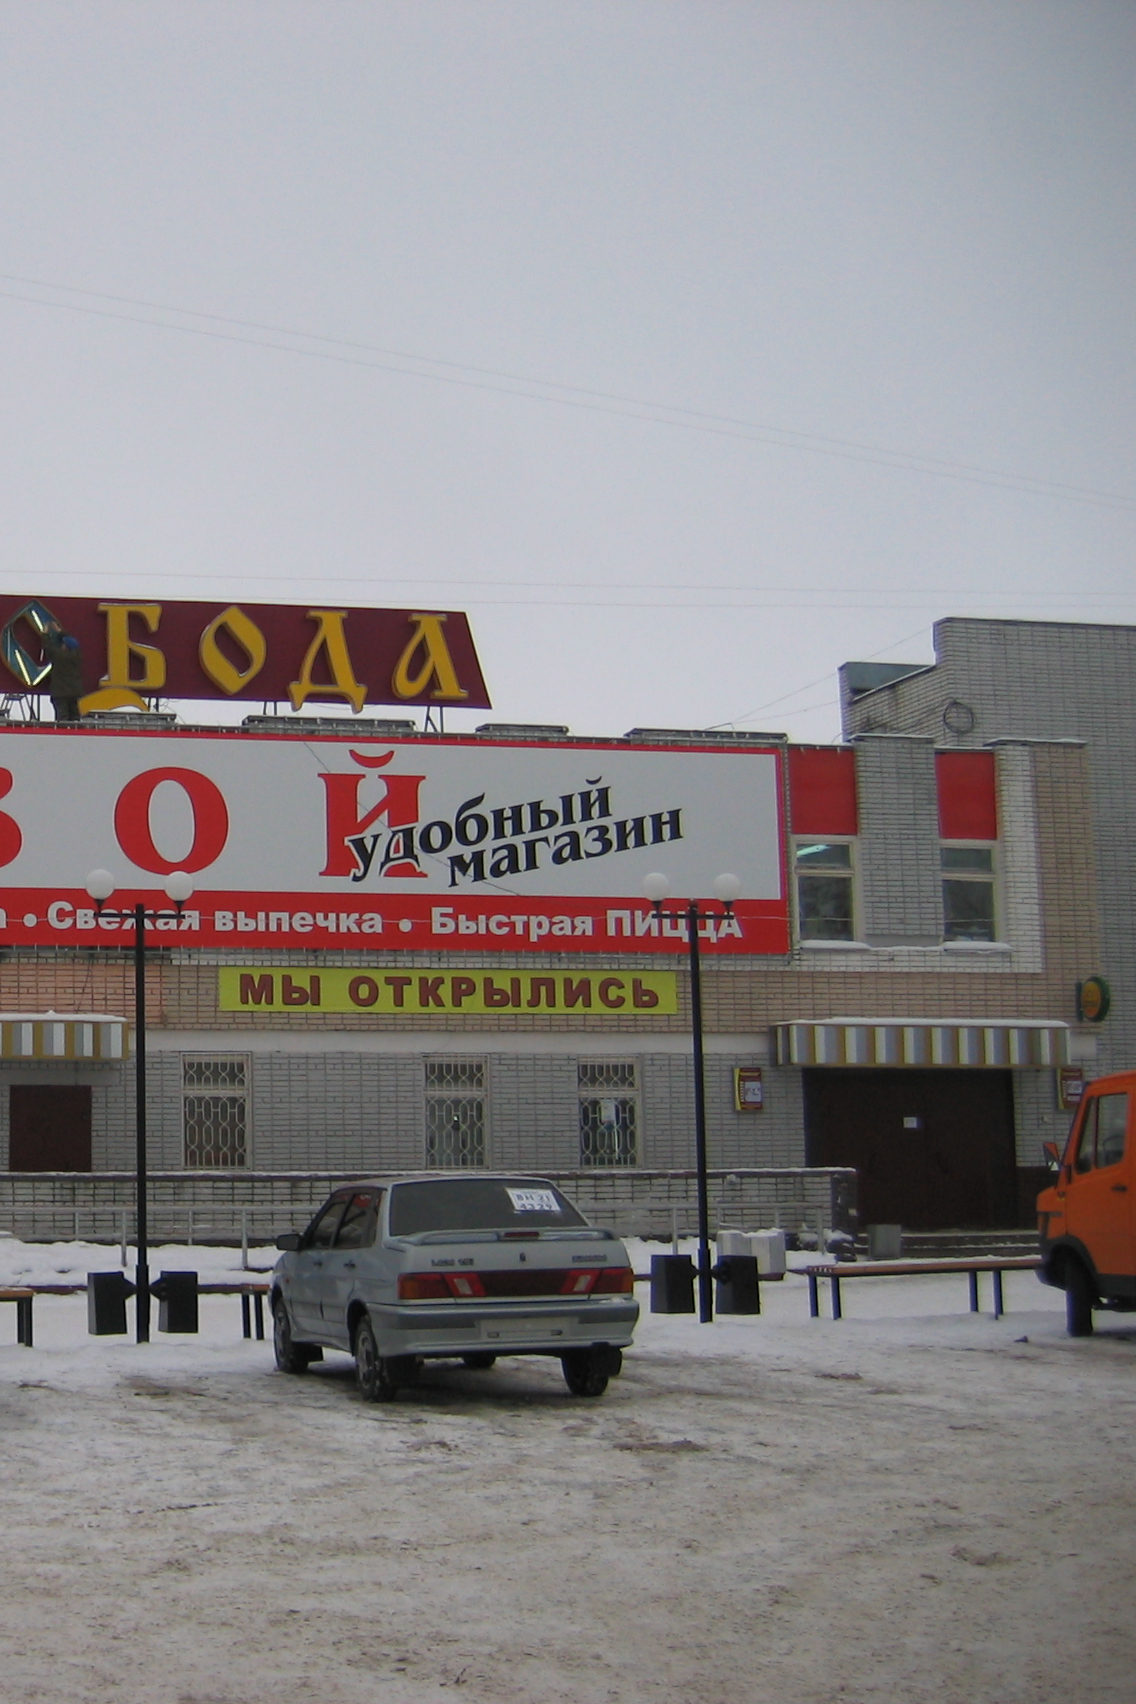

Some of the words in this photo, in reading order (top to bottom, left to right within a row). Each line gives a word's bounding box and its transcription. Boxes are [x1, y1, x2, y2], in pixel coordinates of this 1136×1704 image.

[347, 776, 613, 882] удобный
[448, 808, 684, 887] магазин
[47, 900, 200, 931] Свежая
[214, 910, 383, 934] выпечка
[430, 907, 593, 942] Быстрая
[606, 909, 743, 943] ПИЦЦА
[239, 973, 321, 1007] МЫ
[348, 976, 660, 1008] ОТКРЫЛИСЬ
